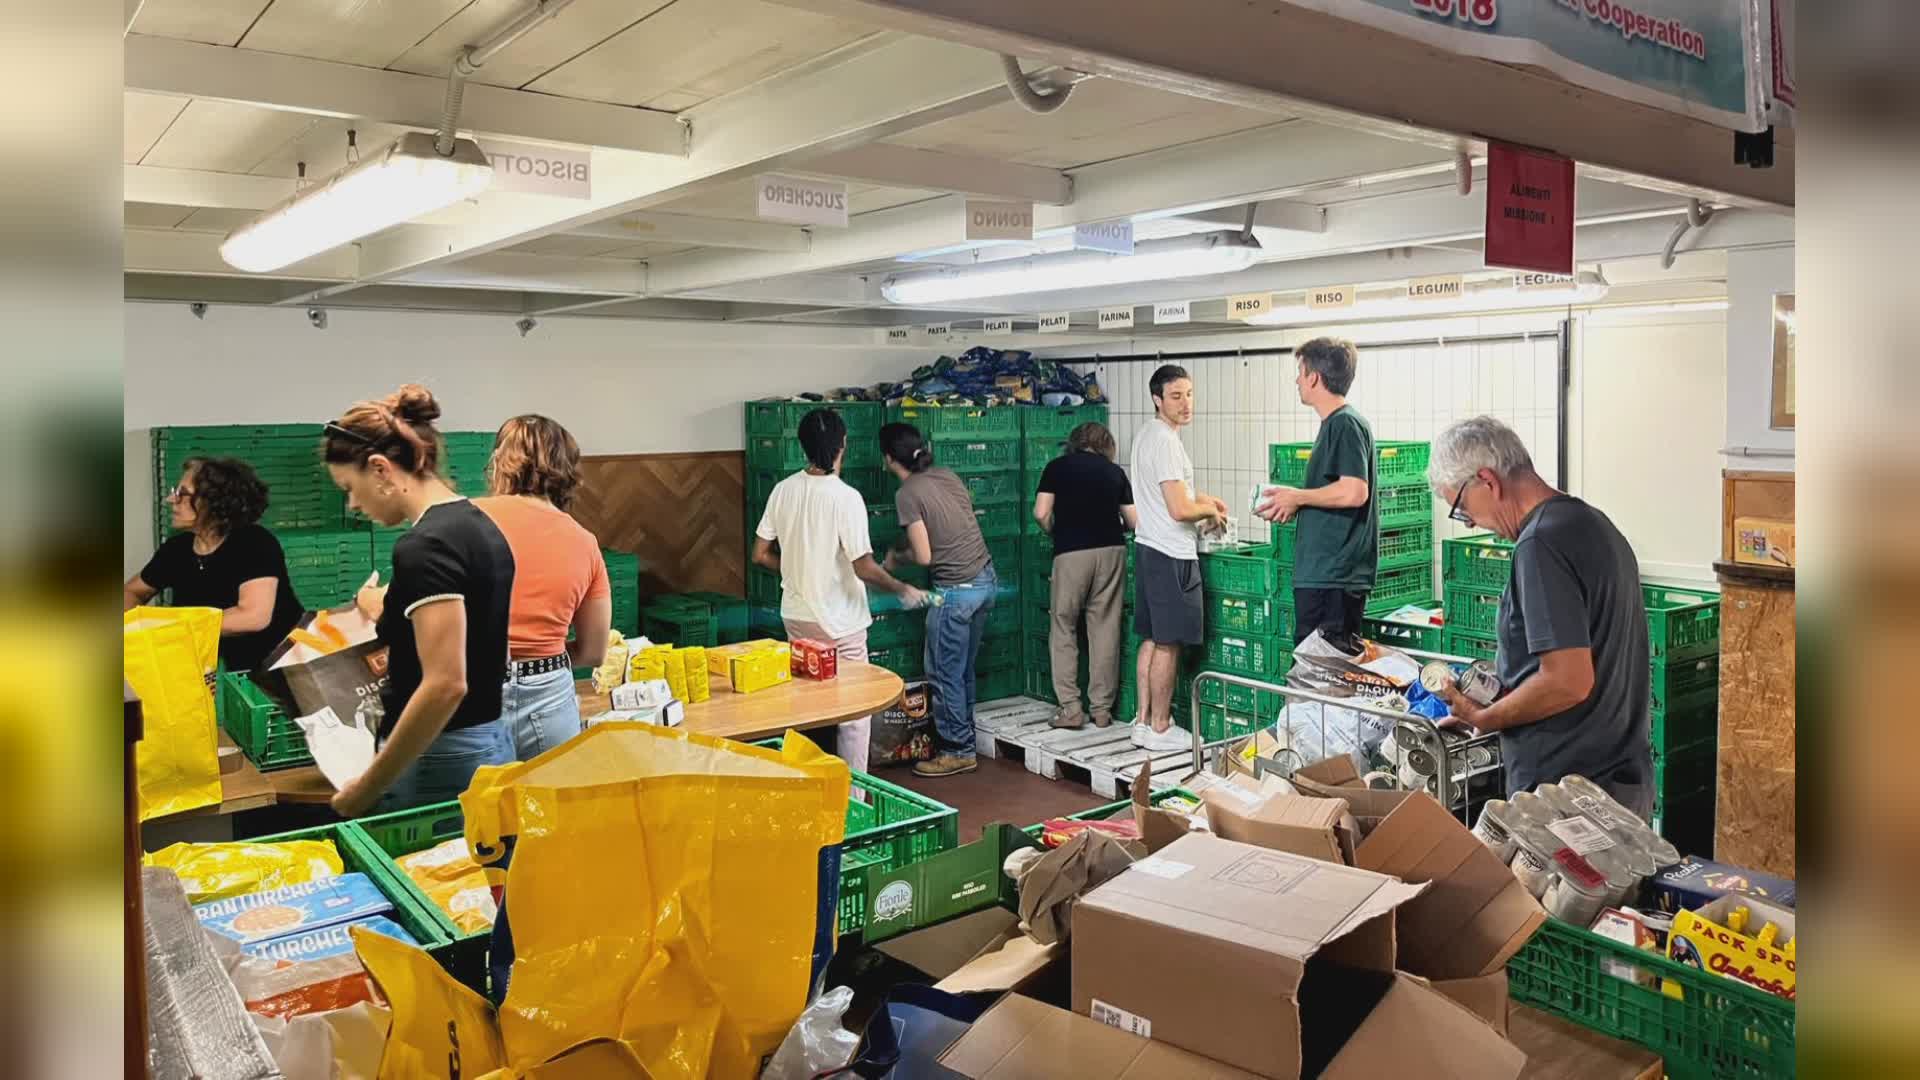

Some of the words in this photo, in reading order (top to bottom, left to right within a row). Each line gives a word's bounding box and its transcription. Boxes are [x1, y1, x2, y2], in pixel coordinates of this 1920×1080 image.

[1583, 0, 1705, 60] Cooperation
[1515, 274, 1574, 286] LEGU
[1408, 282, 1460, 296] LEGUMI
[1315, 292, 1343, 304] RISO
[1235, 299, 1261, 311] RISO
[1100, 311, 1131, 323] FARINA
[1158, 306, 1186, 317] FARINA
[985, 321, 1009, 331] PELATI
[1040, 316, 1066, 327] PELATI
[889, 329, 907, 338] PASTA
[927, 326, 947, 335] PASTA
[355, 677, 390, 697] DISC
[194, 877, 345, 921] RANTURCHESE
[879, 889, 909, 909] Fiorile
[1691, 919, 1747, 952] PACK
